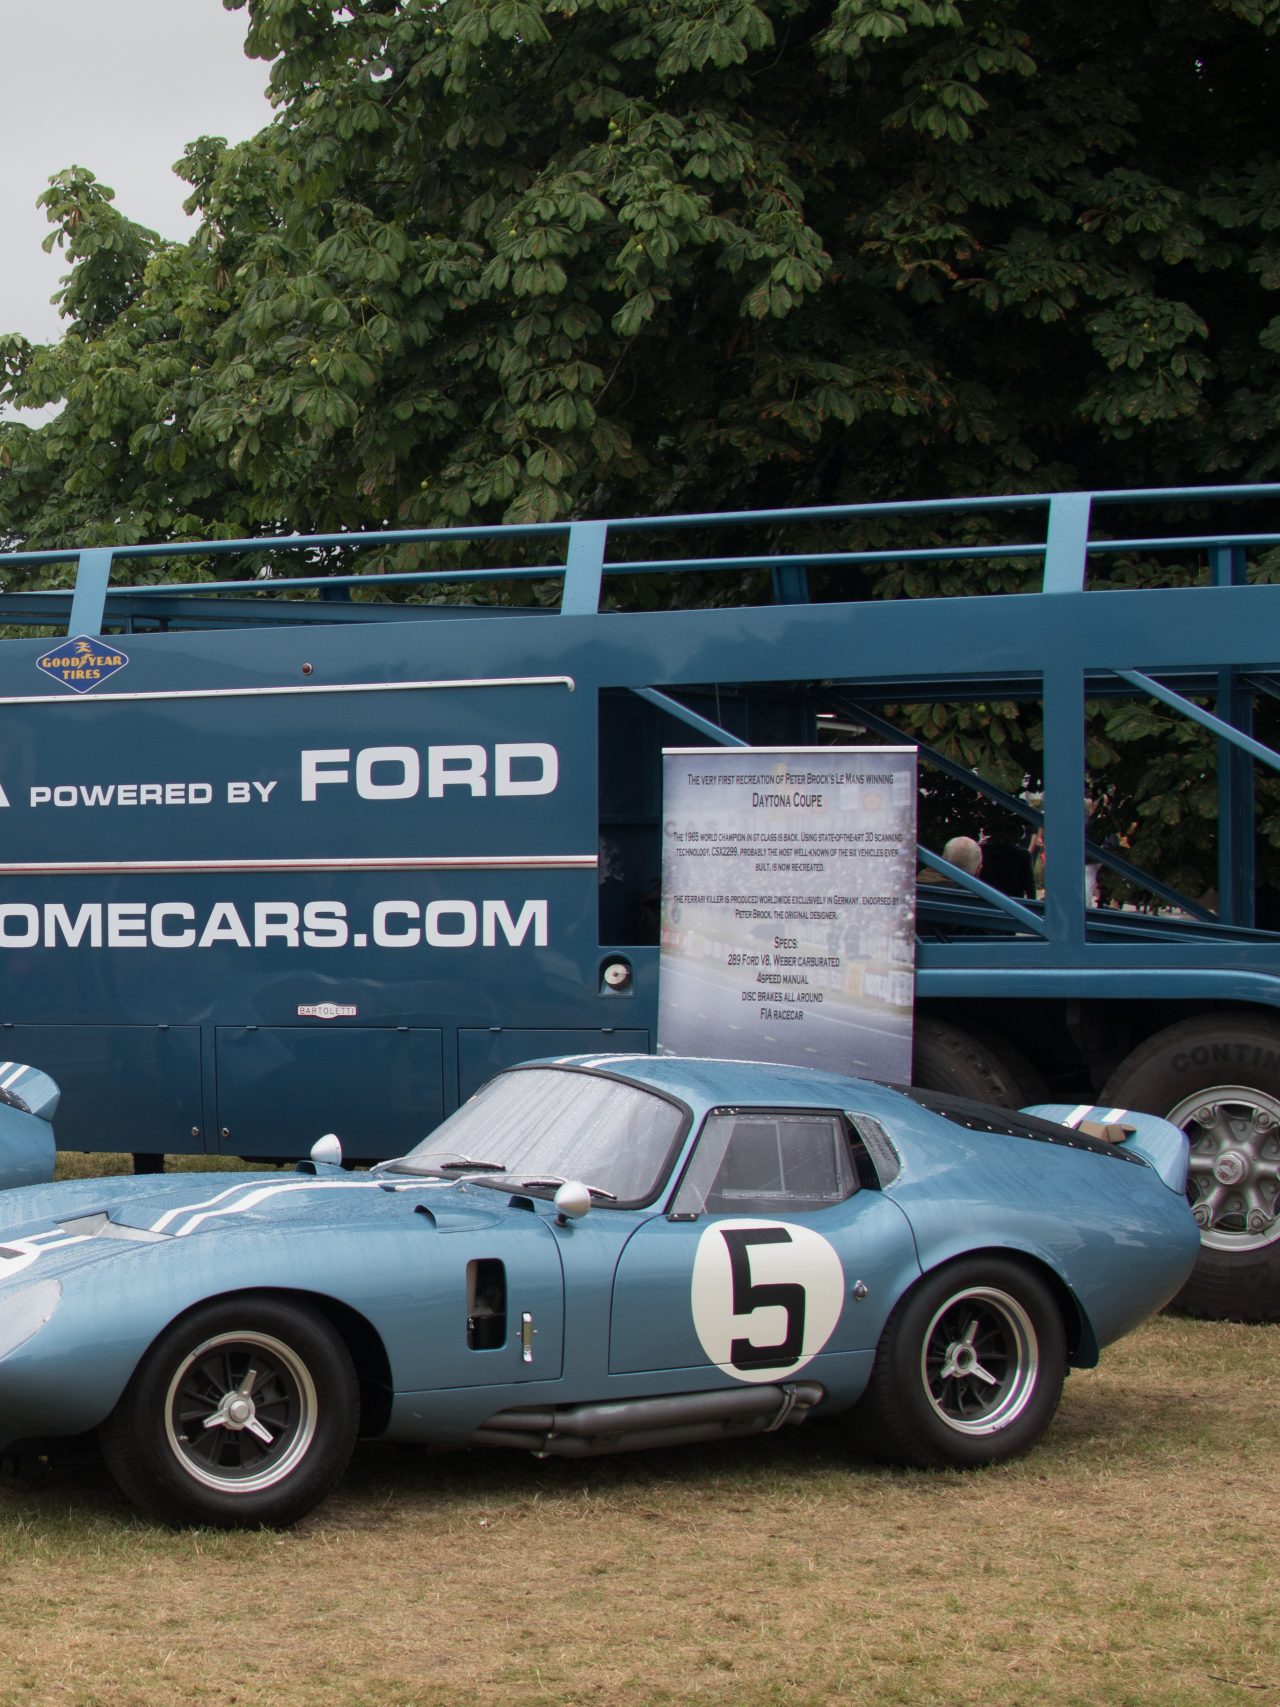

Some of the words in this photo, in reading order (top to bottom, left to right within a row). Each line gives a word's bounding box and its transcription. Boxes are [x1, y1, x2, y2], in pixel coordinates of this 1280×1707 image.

[62, 669, 101, 680] TIRES
[30, 782, 213, 808] POWERED
[227, 780, 277, 804] BY
[300, 742, 559, 802] FORD
[701, 775, 717, 786] VERY
[718, 775, 735, 786] FIRST
[736, 775, 774, 785] RECREATION
[775, 775, 784, 785] OF
[785, 773, 805, 785] PETER
[846, 773, 864, 785] MANS
[866, 774, 894, 785] WINNING
[752, 792, 791, 808] DAYTONA
[792, 792, 823, 808] COUPE
[685, 832, 699, 842] 1965
[735, 909, 751, 919] PETER
[727, 954, 741, 966] 289
[742, 955, 759, 966] FORD
[773, 955, 796, 967] WEBER
[797, 957, 840, 967] CARBURATED
[782, 975, 809, 985] MANUAL
[741, 991, 757, 1002] DISC
[758, 992, 783, 1002] BRAKES
[784, 993, 795, 1003] ALL
[797, 993, 823, 1003] AROUND
[300, 1006, 354, 1015] BARTOLETTI
[760, 1008, 772, 1020] FIA
[773, 1010, 803, 1020] RACECAR
[719, 1227, 806, 1370] 5
